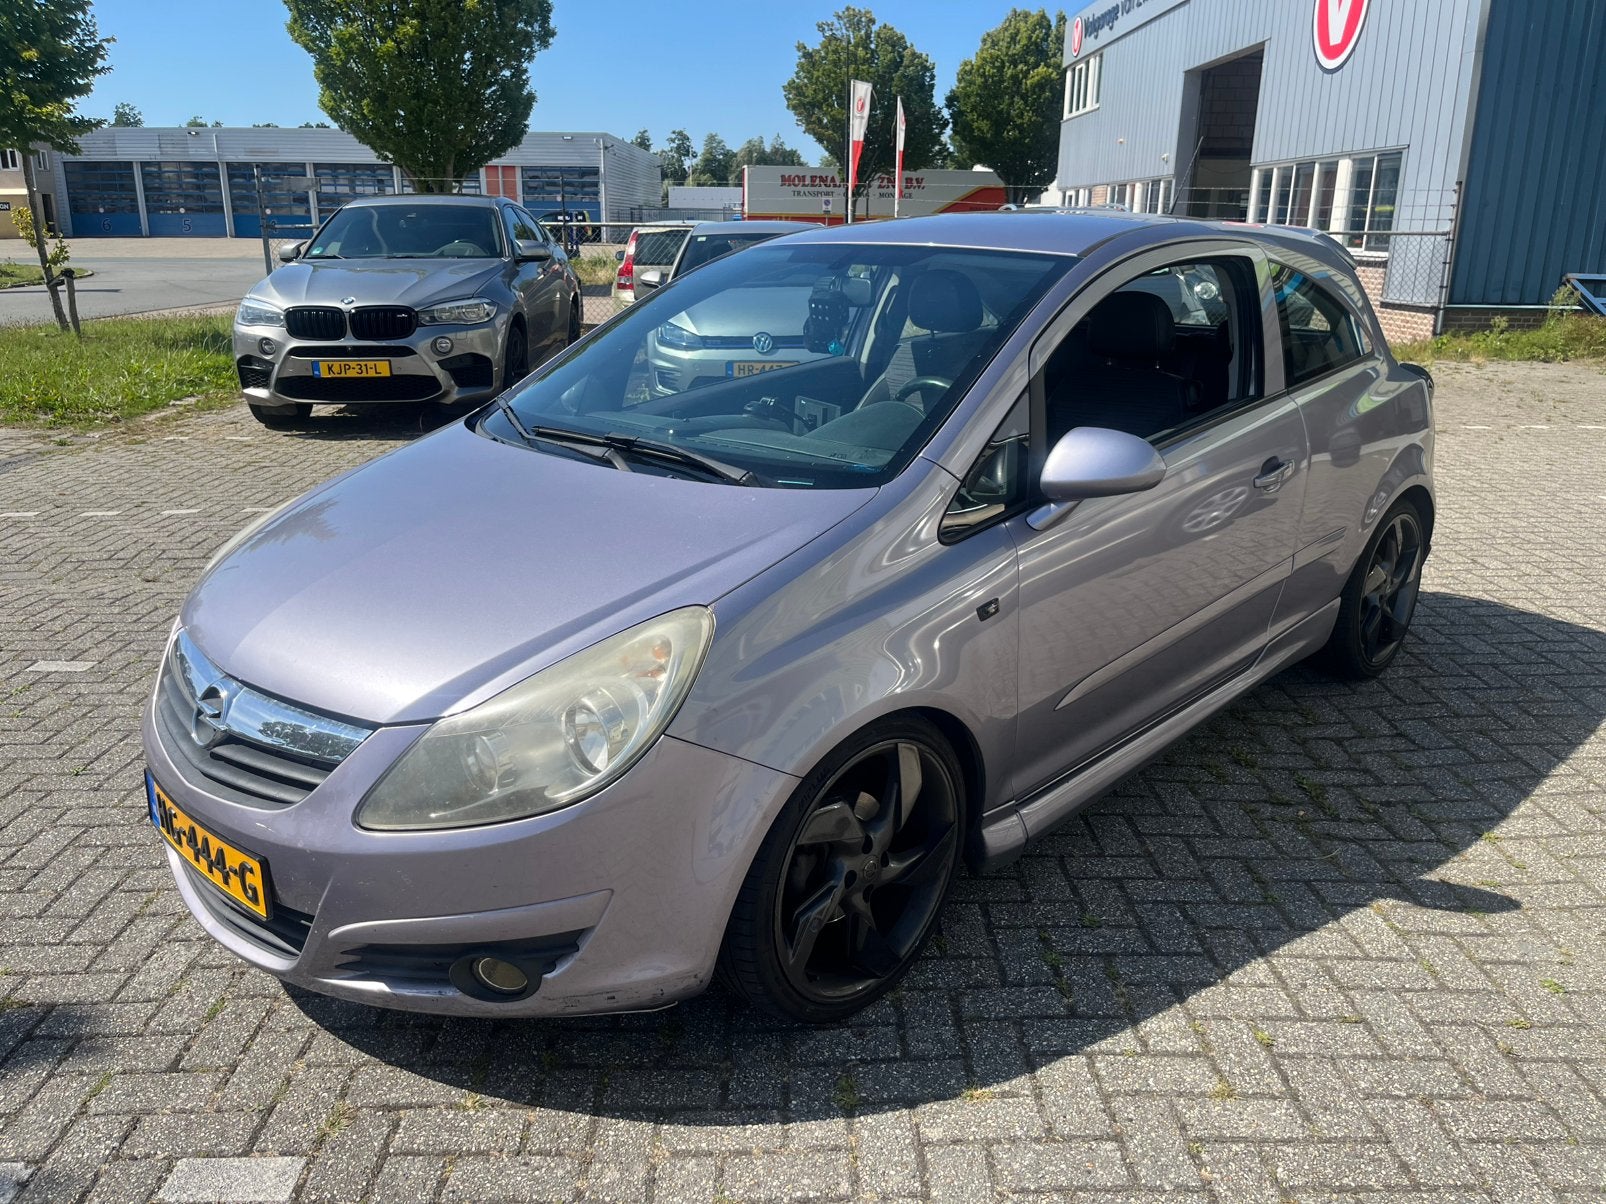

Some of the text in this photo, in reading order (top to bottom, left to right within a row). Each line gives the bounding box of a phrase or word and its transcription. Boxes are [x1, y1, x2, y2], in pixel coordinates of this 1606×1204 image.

[780, 174, 849, 189] MOLENA
[792, 190, 834, 198] TRANSPORT
[102, 219, 111, 232] 6
[182, 219, 192, 232] 5
[327, 363, 382, 375] KJP-31-L
